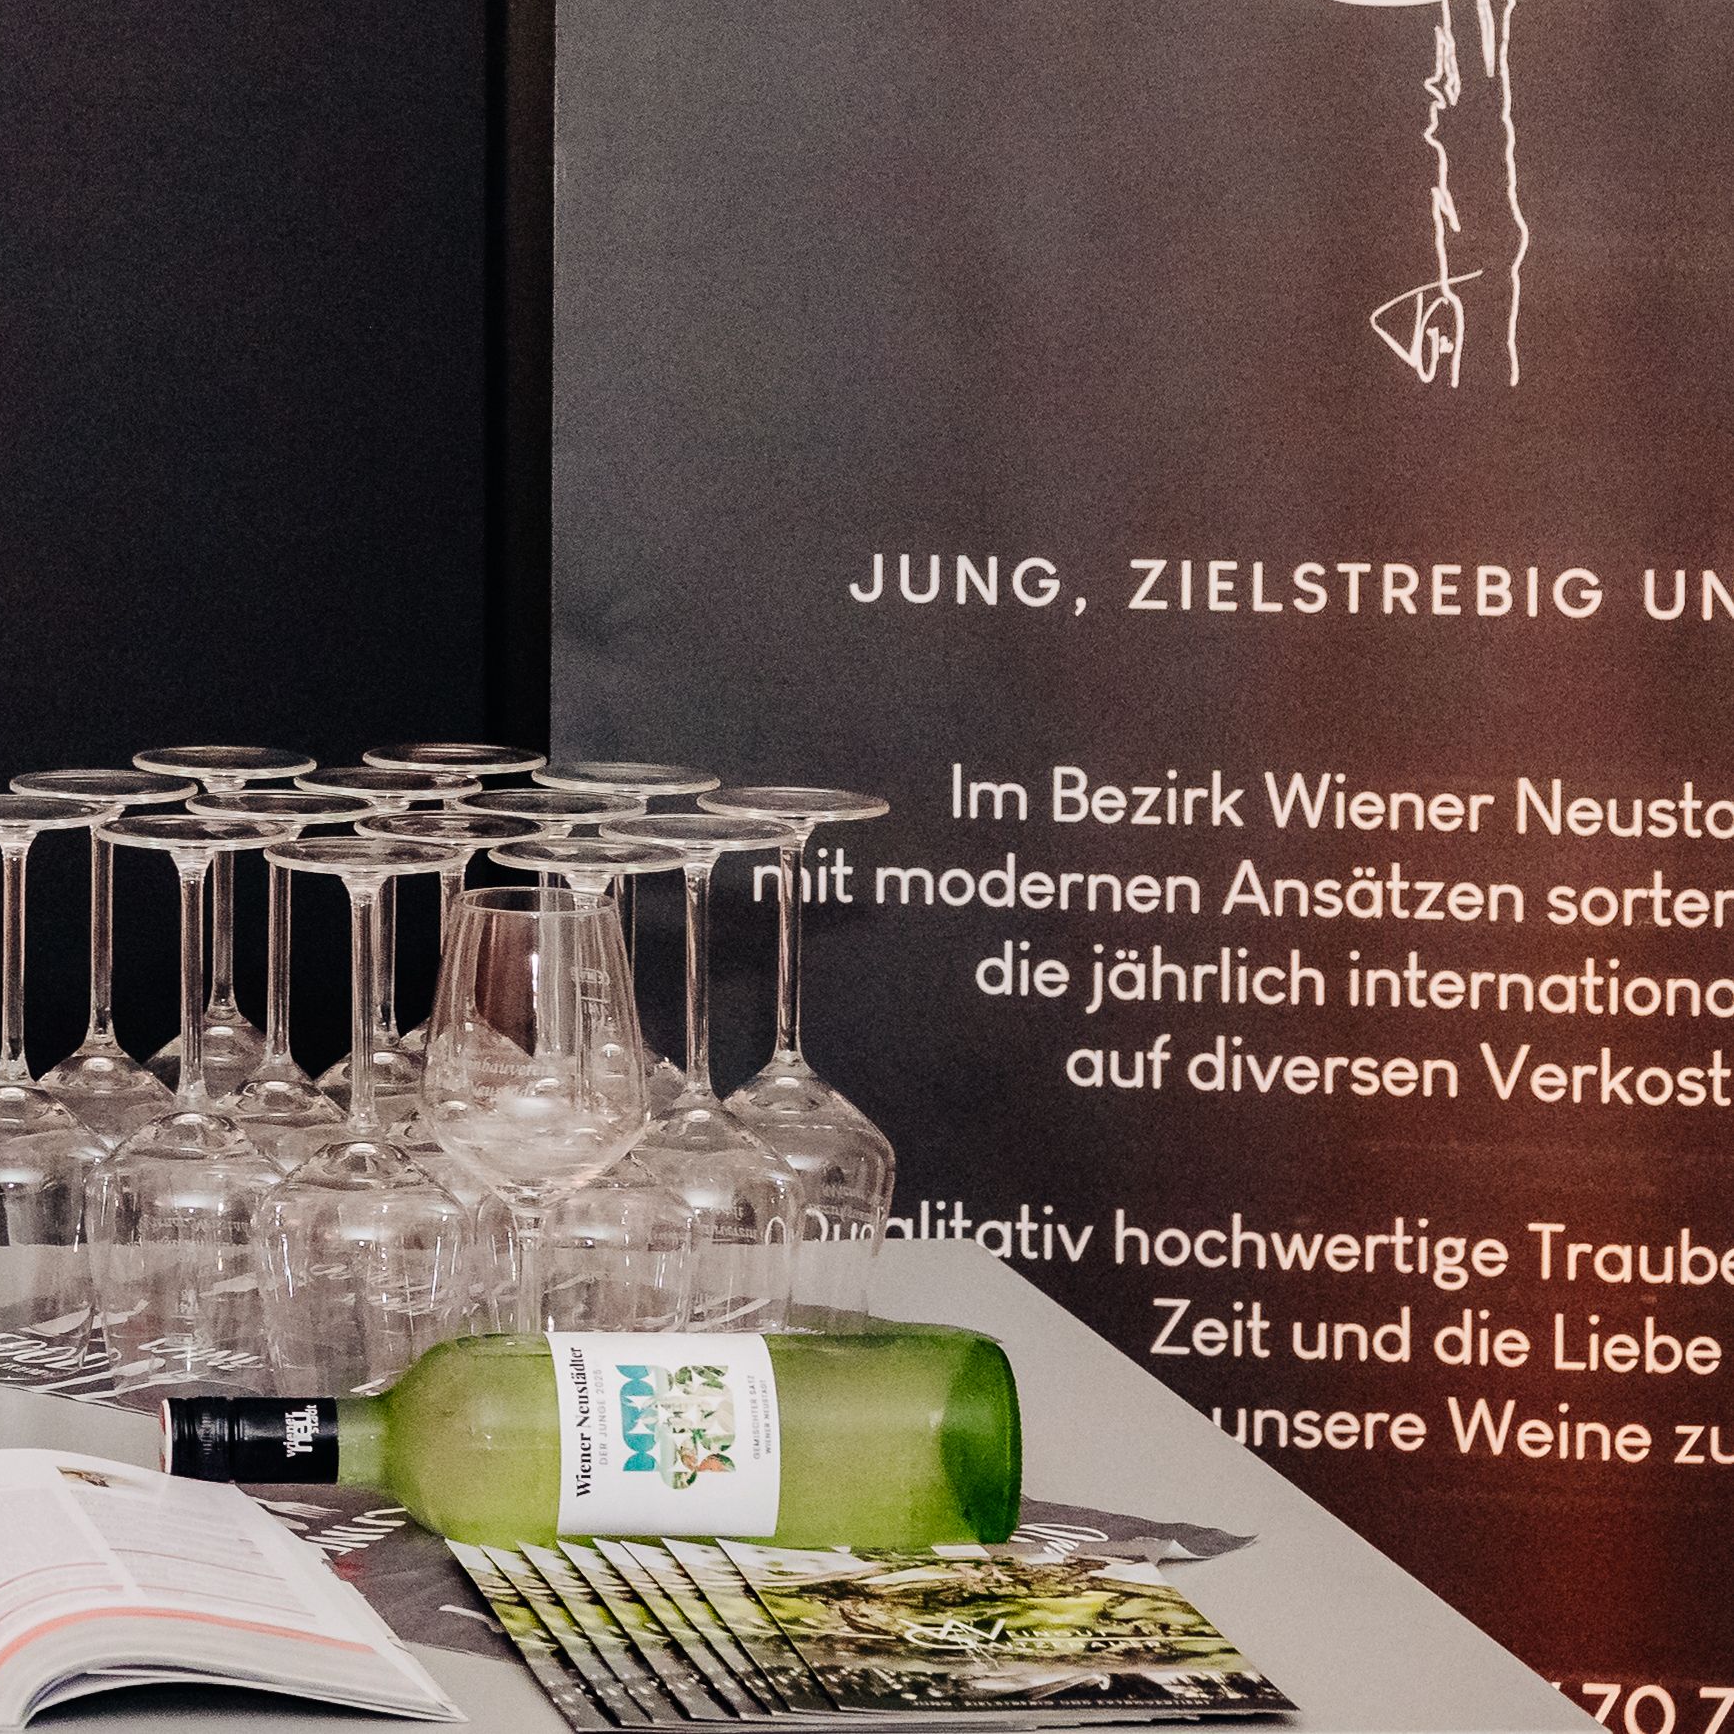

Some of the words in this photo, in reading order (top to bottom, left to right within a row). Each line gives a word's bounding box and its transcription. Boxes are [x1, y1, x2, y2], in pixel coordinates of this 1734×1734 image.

[850, 554, 1086, 615] JUNG,
[1129, 560, 1602, 618] ZIELSTREBIG
[954, 764, 1026, 820] Im
[1054, 767, 1243, 826] Bezirk
[1265, 772, 1494, 831] Wiener
[752, 848, 853, 906] mit
[877, 853, 1199, 913] modernen
[1223, 860, 1523, 922] Ansätzen
[976, 941, 1069, 996] die
[1086, 945, 1324, 1013] jährlich
[1067, 1035, 1170, 1088] auf
[1189, 1036, 1457, 1097] diversen
[1481, 1043, 1730, 1106] Verkost
[1116, 1210, 1508, 1290] hochwertige
[1152, 1299, 1269, 1357] Zeit
[1294, 1307, 1409, 1361] und
[1435, 1309, 1529, 1366] die
[1555, 1314, 1721, 1374] Liebe
[569, 1346, 591, 1428] Neustädter
[593, 1369, 605, 1395] 2025
[596, 1398, 608, 1438] JUNGE
[1213, 1407, 1427, 1452] unsere
[1449, 1398, 1651, 1462] Weine
[575, 1432, 592, 1498] Wiener
[598, 1443, 608, 1465] DER
